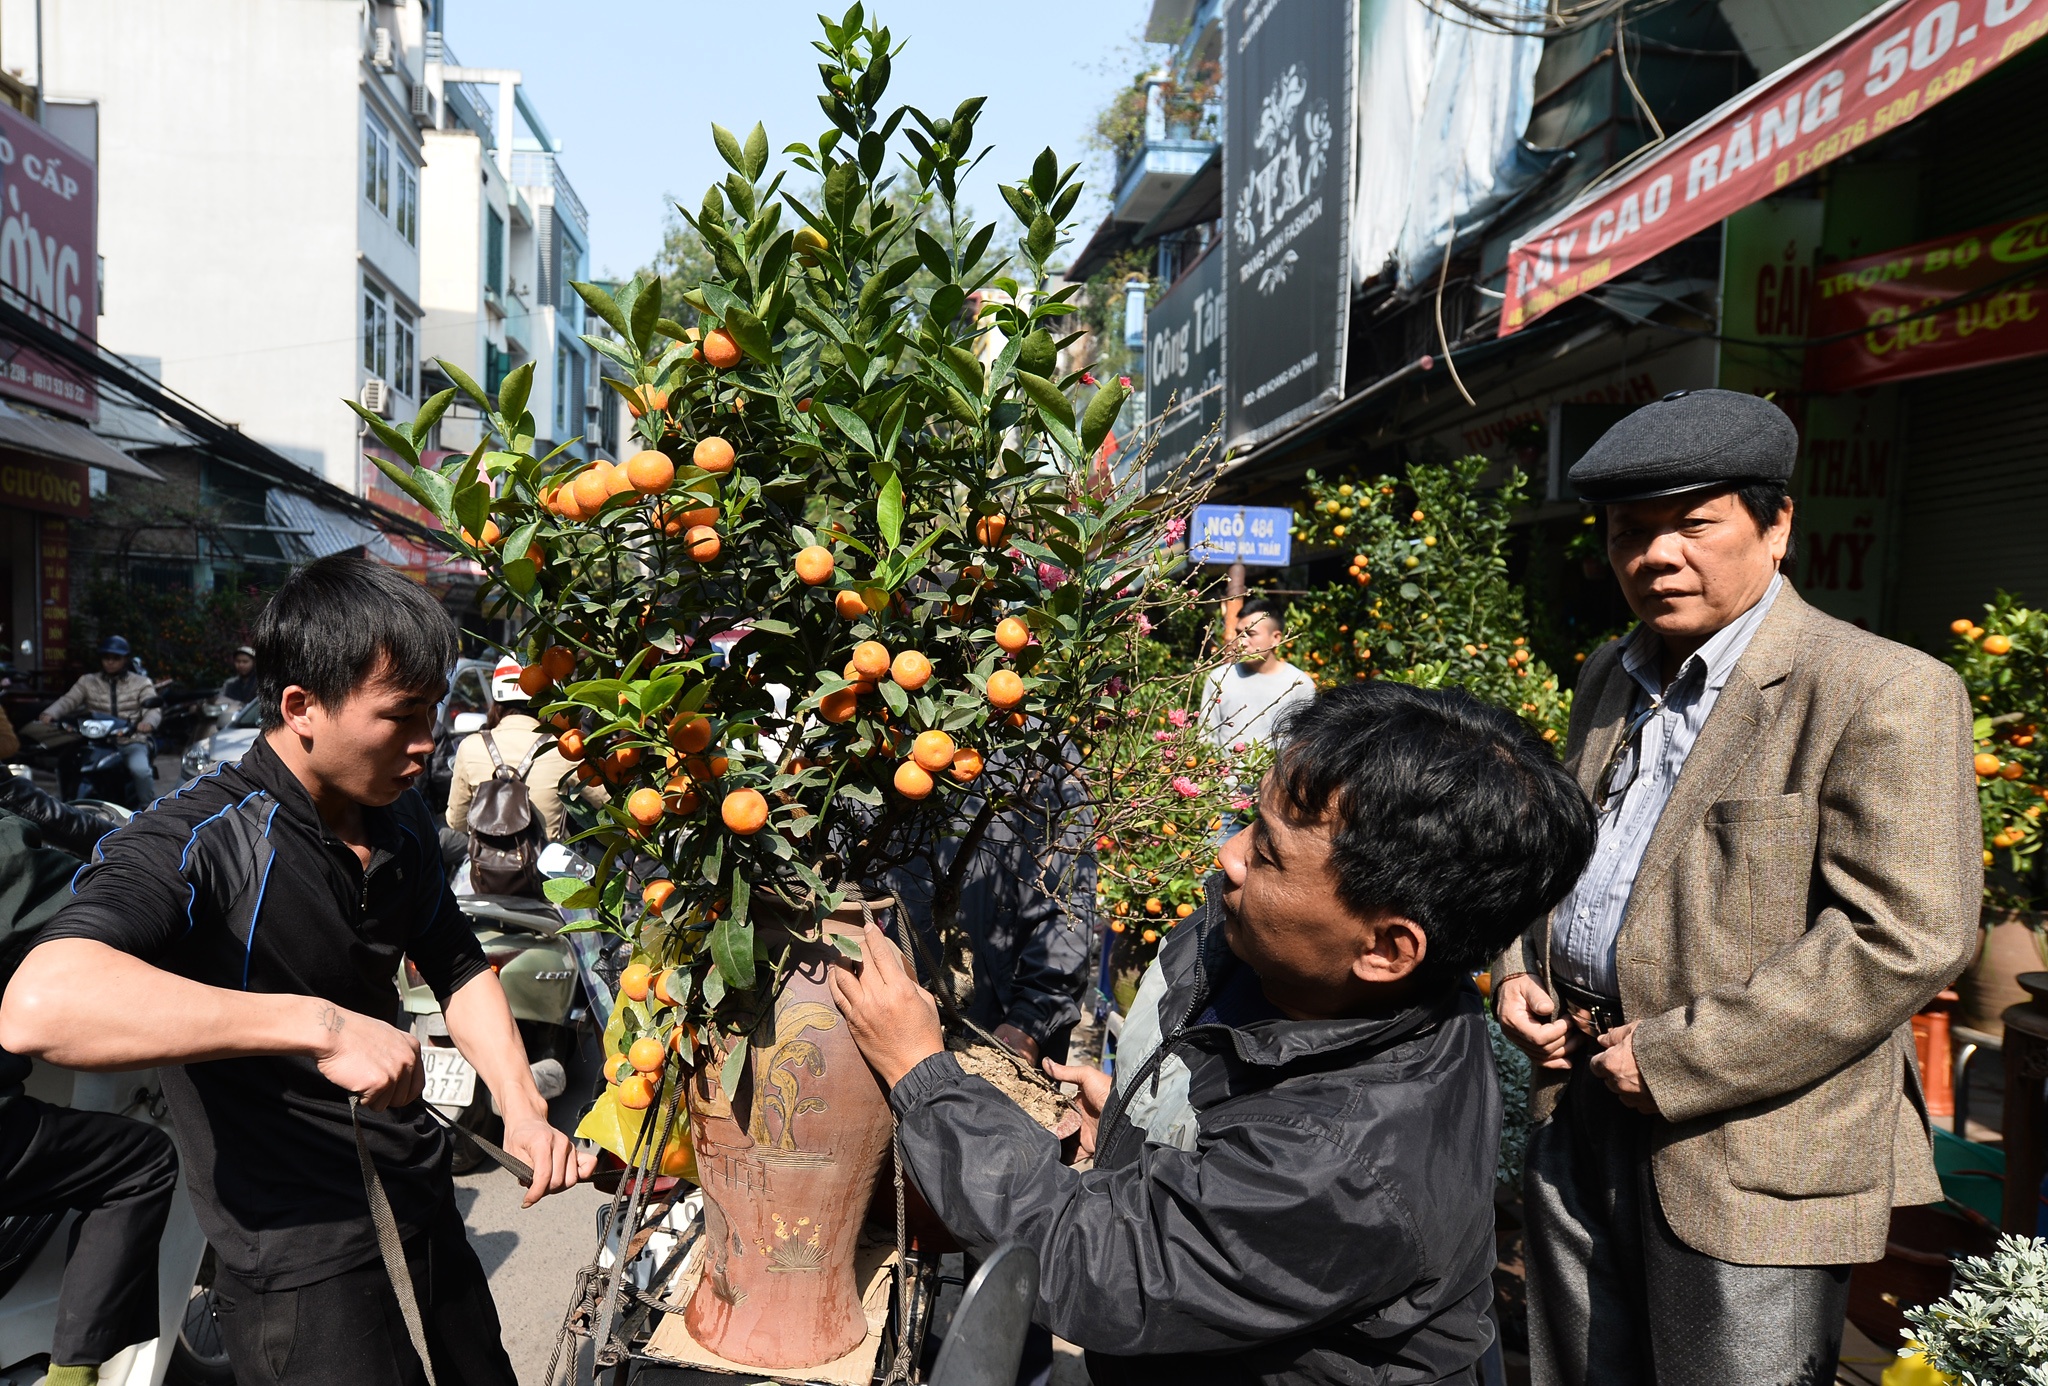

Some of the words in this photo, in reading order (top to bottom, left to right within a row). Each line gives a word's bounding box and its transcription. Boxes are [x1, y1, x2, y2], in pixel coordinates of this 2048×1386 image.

[1872, 89, 1920, 135] 500
[1924, 56, 1978, 106] 938
[23, 154, 79, 201] CẤP
[1585, 173, 1674, 256] CAO
[1685, 69, 1846, 202] RĂNG
[1284, 196, 1323, 245] FASHION
[1152, 326, 1191, 387] Công
[1207, 512, 1245, 537] NGÕ
[1250, 517, 1274, 539] 484
[1805, 515, 1875, 590] MỸ
